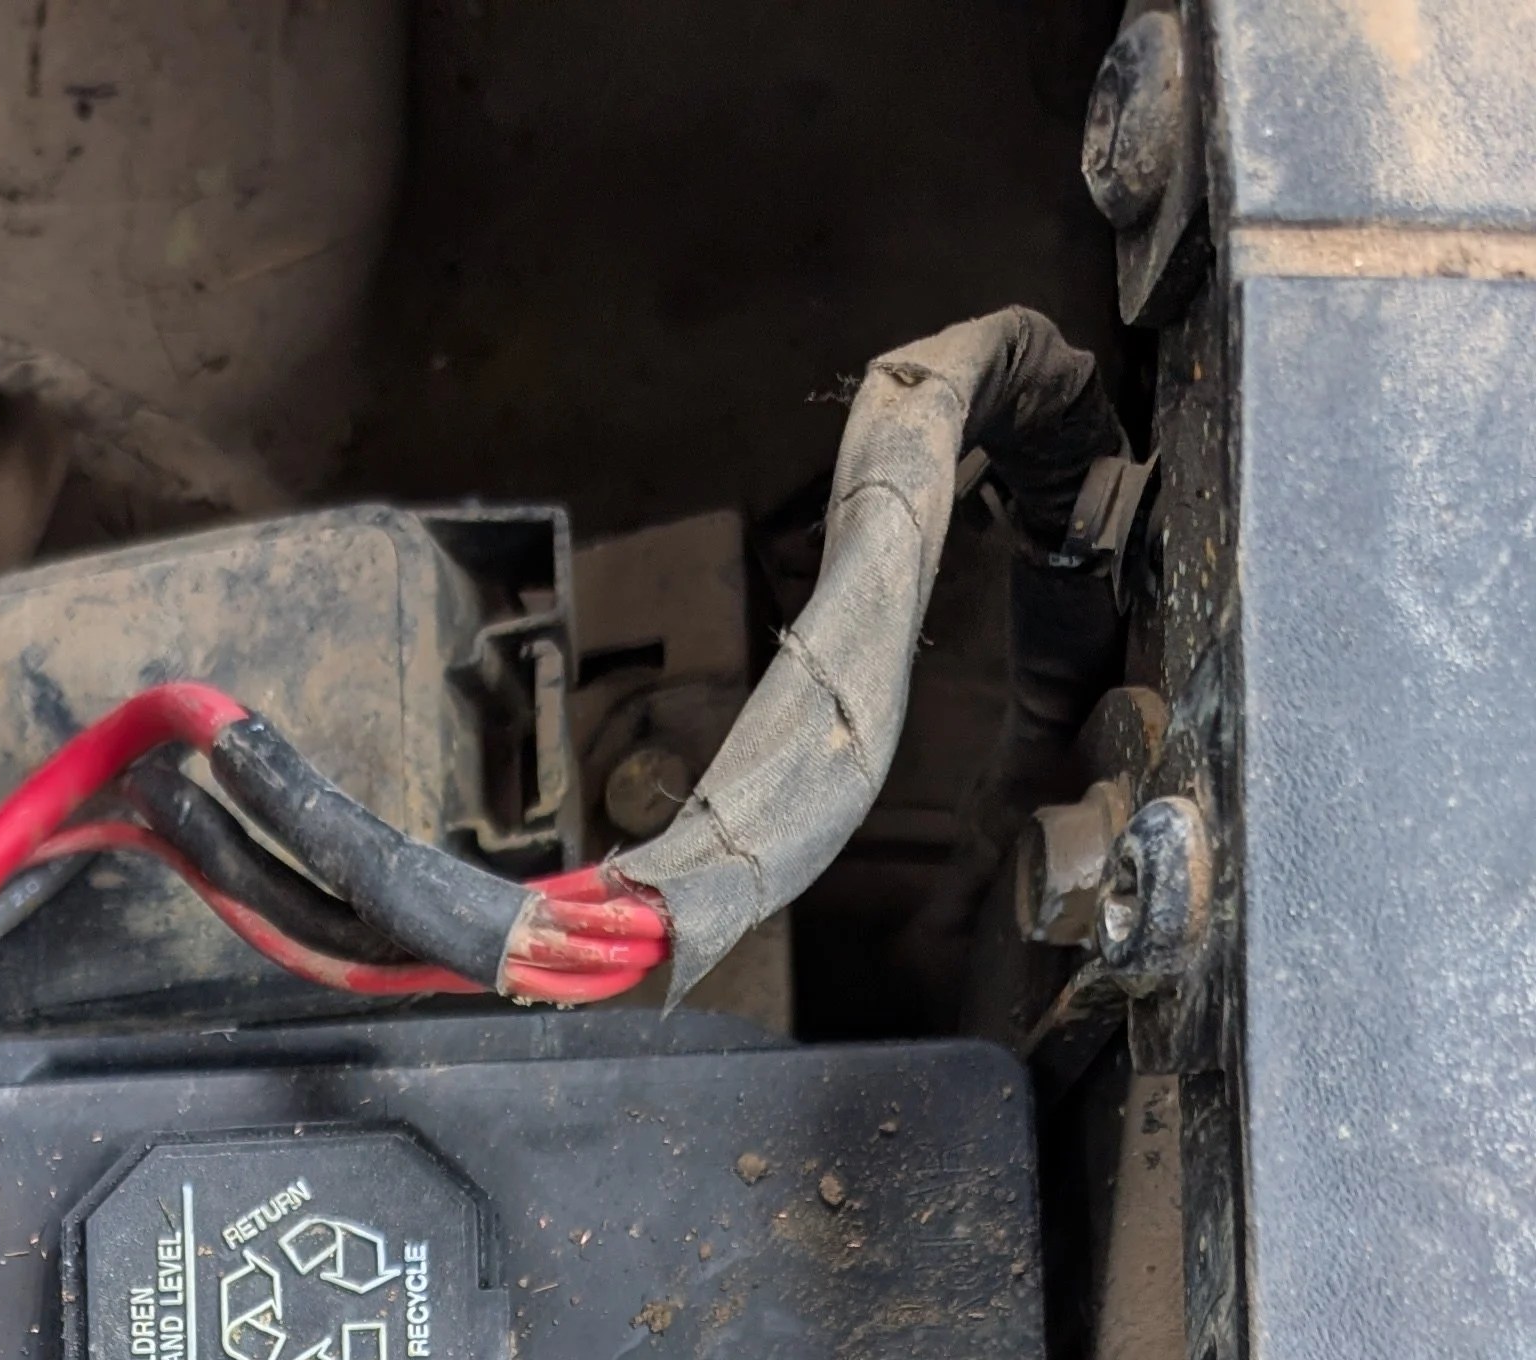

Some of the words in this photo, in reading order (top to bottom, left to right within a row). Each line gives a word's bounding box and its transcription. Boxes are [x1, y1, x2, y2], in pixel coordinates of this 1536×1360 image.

[222, 1178, 312, 1250] RETURN
[158, 1230, 183, 1305] LEVEL
[404, 1242, 430, 1358] RECYCLE
